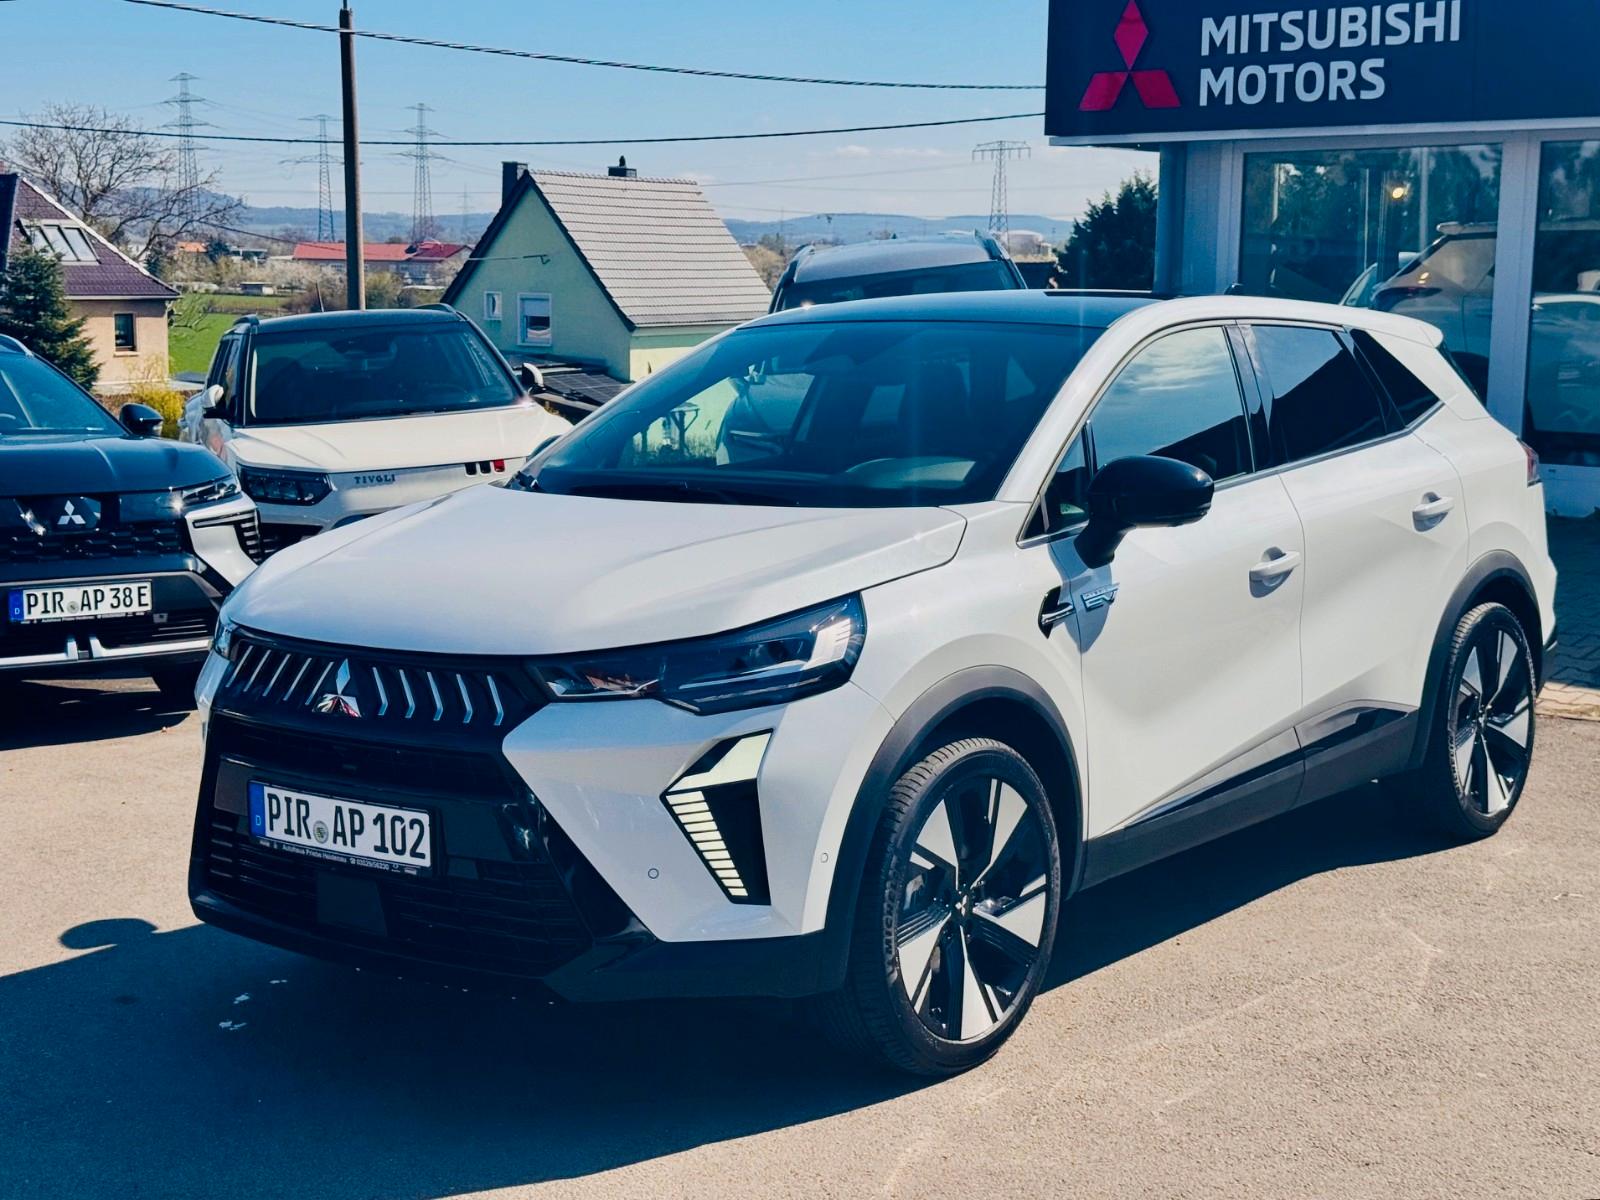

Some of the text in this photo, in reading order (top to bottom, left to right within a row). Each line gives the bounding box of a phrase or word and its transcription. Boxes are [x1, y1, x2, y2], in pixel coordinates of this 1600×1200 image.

[1201, 0, 1461, 56] MITSUBISHI
[1199, 58, 1386, 106] MOTORS
[354, 474, 395, 484] TIVOLI
[14, 607, 20, 615] D
[26, 591, 65, 615] PIR
[80, 589, 105, 611] AP
[255, 793, 426, 860] D PIR AP 102
